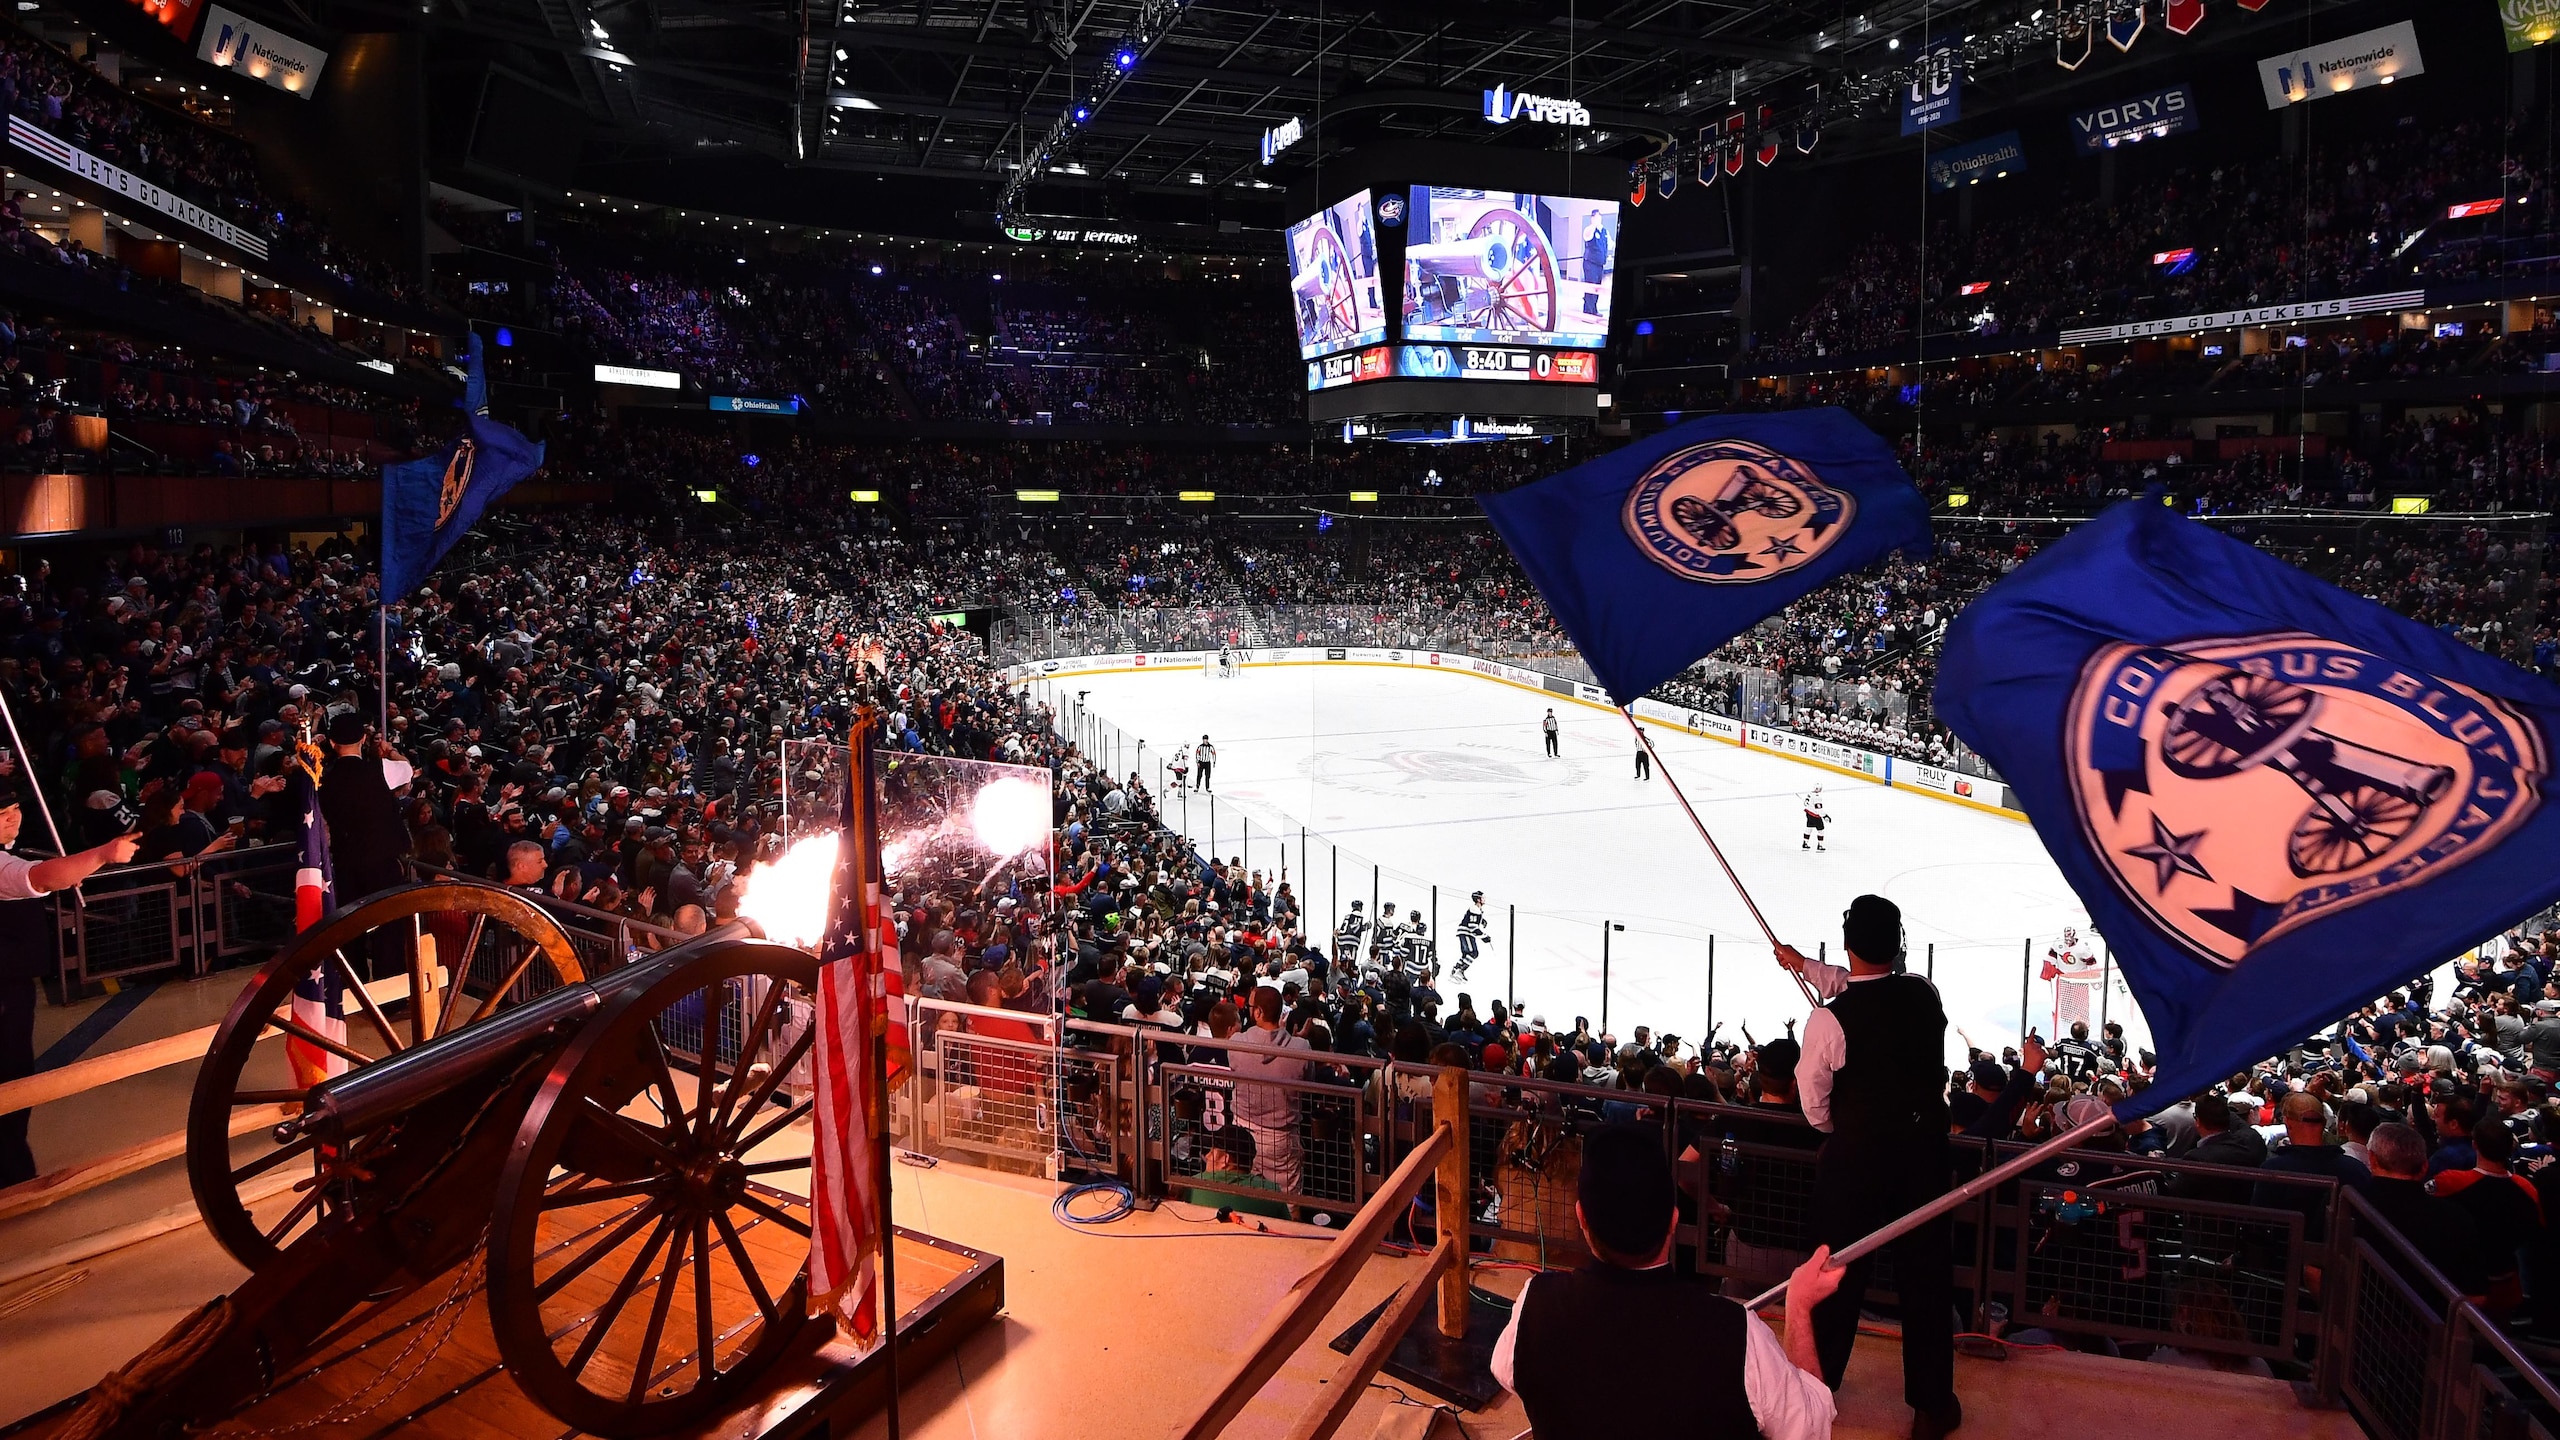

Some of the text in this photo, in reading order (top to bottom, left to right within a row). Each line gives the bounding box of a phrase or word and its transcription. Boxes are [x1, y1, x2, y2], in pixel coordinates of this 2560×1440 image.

[253, 43, 306, 74] Nationwide
[2319, 46, 2395, 74] Nationwide
[1509, 92, 1590, 127] Arena
[2076, 91, 2185, 132] VORYS
[2105, 128, 2132, 139] OFFICIAL
[2133, 119, 2168, 133] CORPORATE
[1952, 146, 2018, 173] OhioHealth
[77, 153, 232, 241] LET'S GO JACKETS
[2117, 302, 2341, 336] LET'S GO JACKETS
[1433, 351, 1447, 373] 0
[1467, 351, 1507, 371] 8:40
[1536, 354, 1550, 377] 0
[743, 401, 780, 410] OhioHealth
[1473, 422, 1534, 435] Nationwide
[1638, 480, 1712, 570] COLUMBUS
[168, 528, 183, 545] 113
[1163, 656, 1202, 664] Nationwide
[1441, 657, 1461, 665] TOYOTA
[1473, 660, 1502, 677] LUCAS OIL
[2104, 652, 2365, 729] COLBUS
[1641, 704, 1680, 721] Columbia Gas
[1712, 720, 1733, 732] PIZZA
[1817, 743, 1841, 759] BREWDOG
[1916, 766, 1947, 782] TRULY
[1415, 944, 1428, 964] 17
[2063, 1054, 2084, 1076] 17
[1202, 1090, 1225, 1131] 8
[2118, 1209, 2147, 1280] 5
